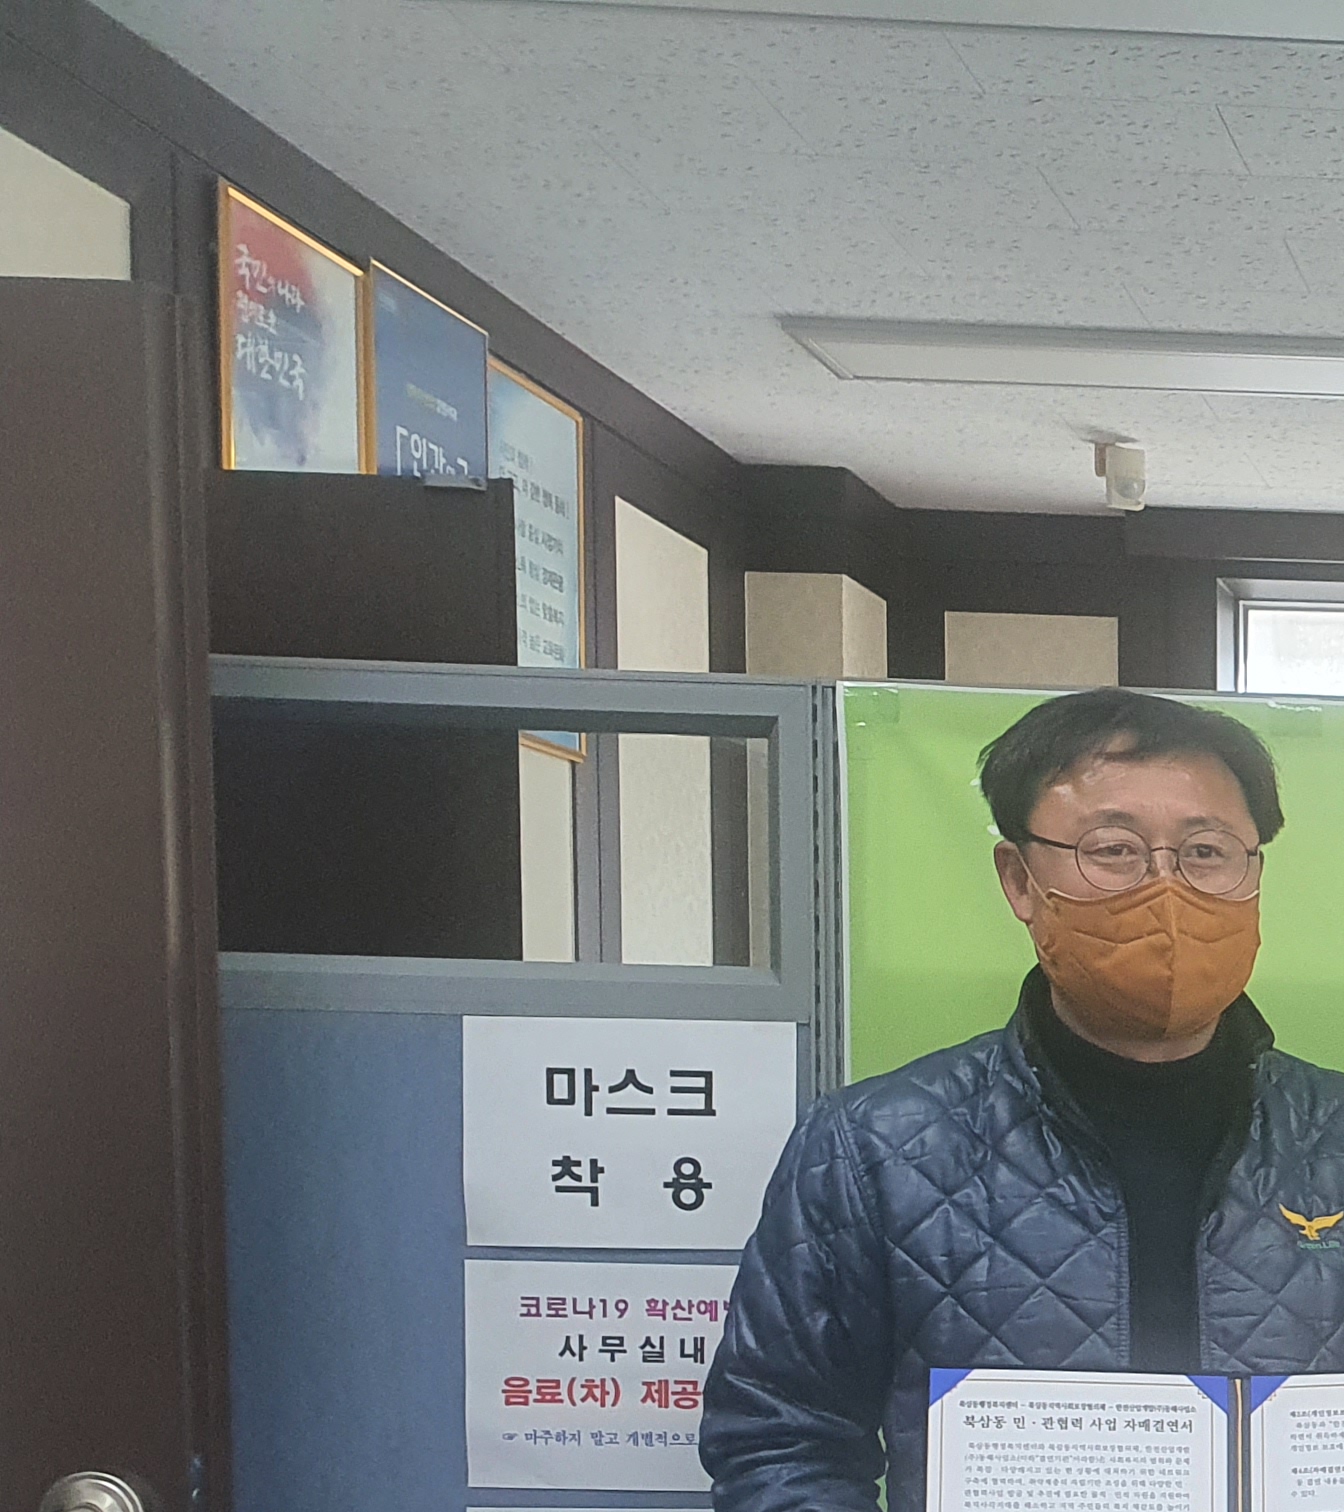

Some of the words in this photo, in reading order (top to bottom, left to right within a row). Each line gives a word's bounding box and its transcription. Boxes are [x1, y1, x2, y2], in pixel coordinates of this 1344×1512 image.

[545, 1067, 717, 1117] 마스크
[519, 1296, 629, 1320] 코로나19
[645, 1298, 731, 1321] 확산예
[501, 1376, 621, 1408] 음료(차)
[963, 1415, 1007, 1429] 북삼동
[1089, 1418, 1117, 1432] 사업
[525, 1430, 581, 1446] 마주하지
[590, 1430, 620, 1446] 말고
